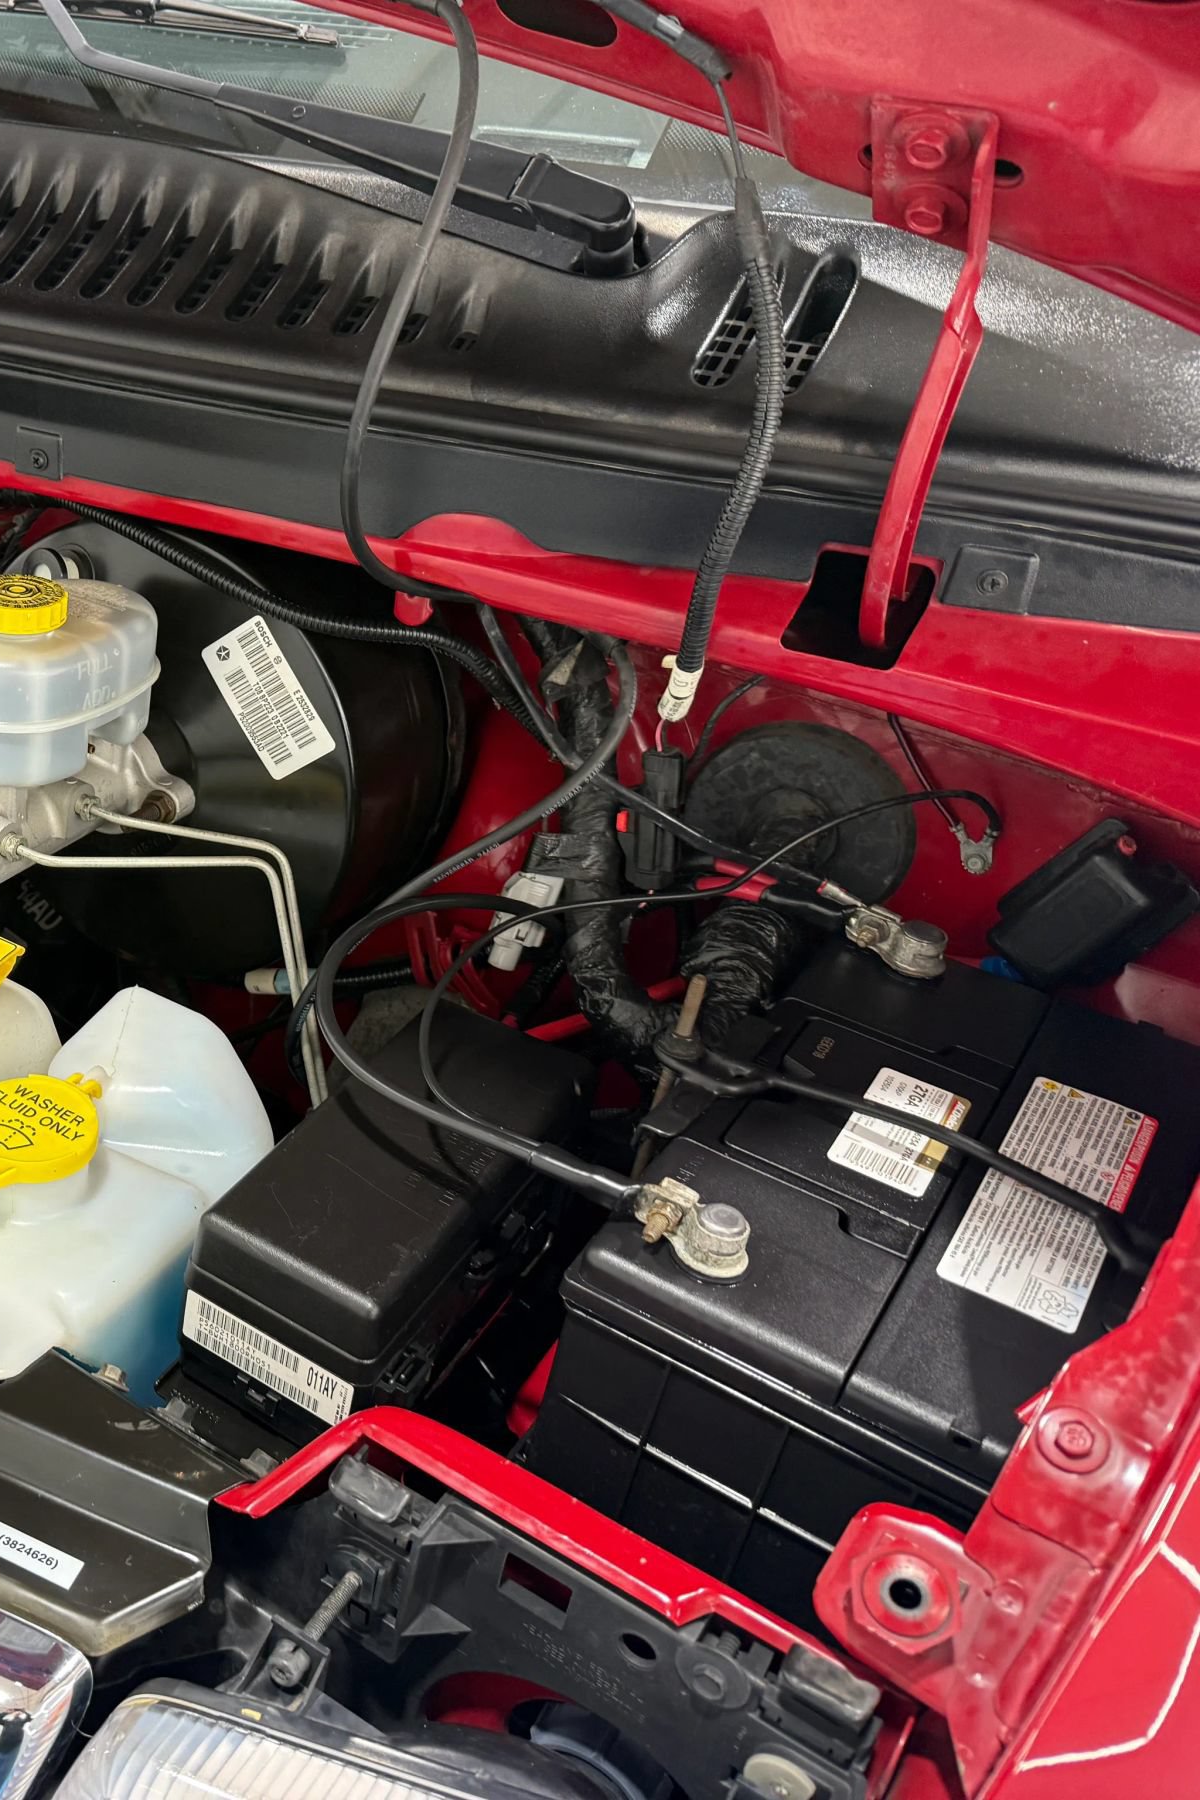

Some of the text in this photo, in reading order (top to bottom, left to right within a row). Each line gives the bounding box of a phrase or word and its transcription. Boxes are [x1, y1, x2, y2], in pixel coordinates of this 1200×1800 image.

[254, 621, 272, 648] BOSCH
[78, 653, 112, 680] FULL
[14, 1084, 85, 1126] WASHER
[905, 1084, 928, 1108] 27GA
[39, 1116, 84, 1141] ONLY
[306, 1367, 337, 1400] 011AY
